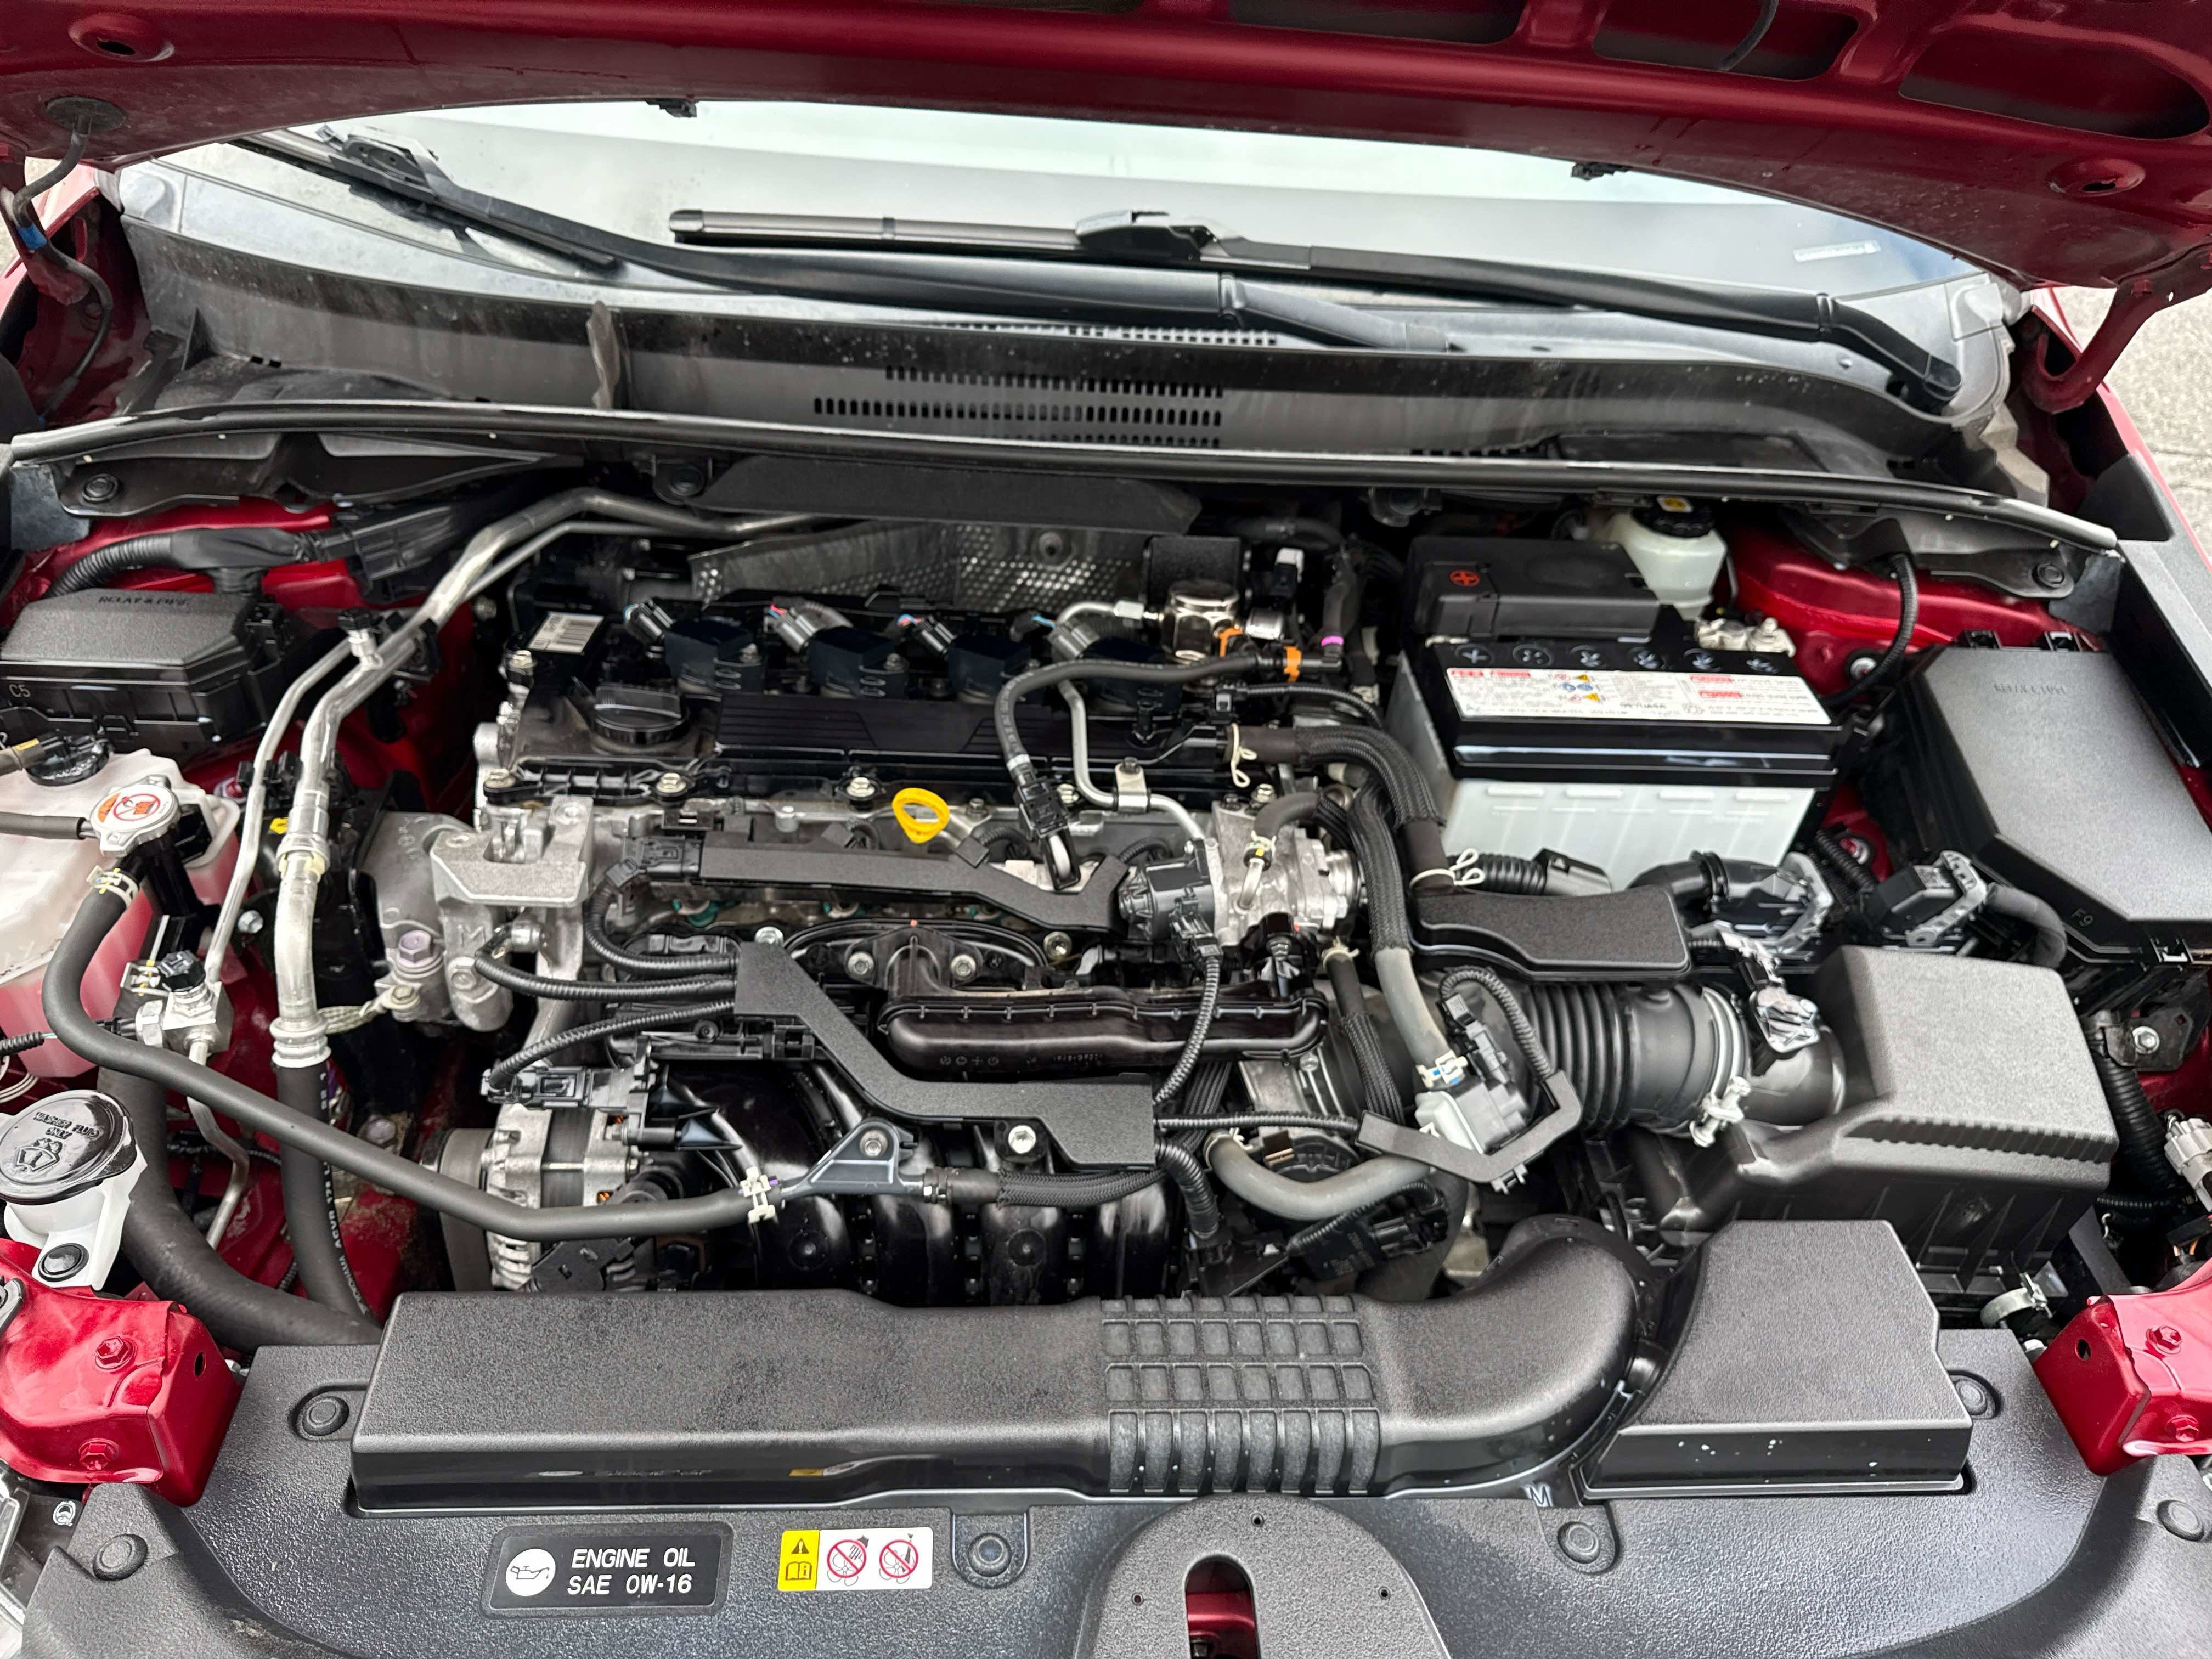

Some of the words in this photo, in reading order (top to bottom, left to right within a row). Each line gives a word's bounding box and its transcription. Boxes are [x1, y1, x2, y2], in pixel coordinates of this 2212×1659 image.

[9, 684, 31, 698] C5
[2071, 908, 2094, 927] F9
[571, 1548, 650, 1568] ENGINE
[663, 1547, 696, 1567] OIL
[567, 1574, 612, 1595] SAE
[625, 1573, 692, 1594] 0W-16
